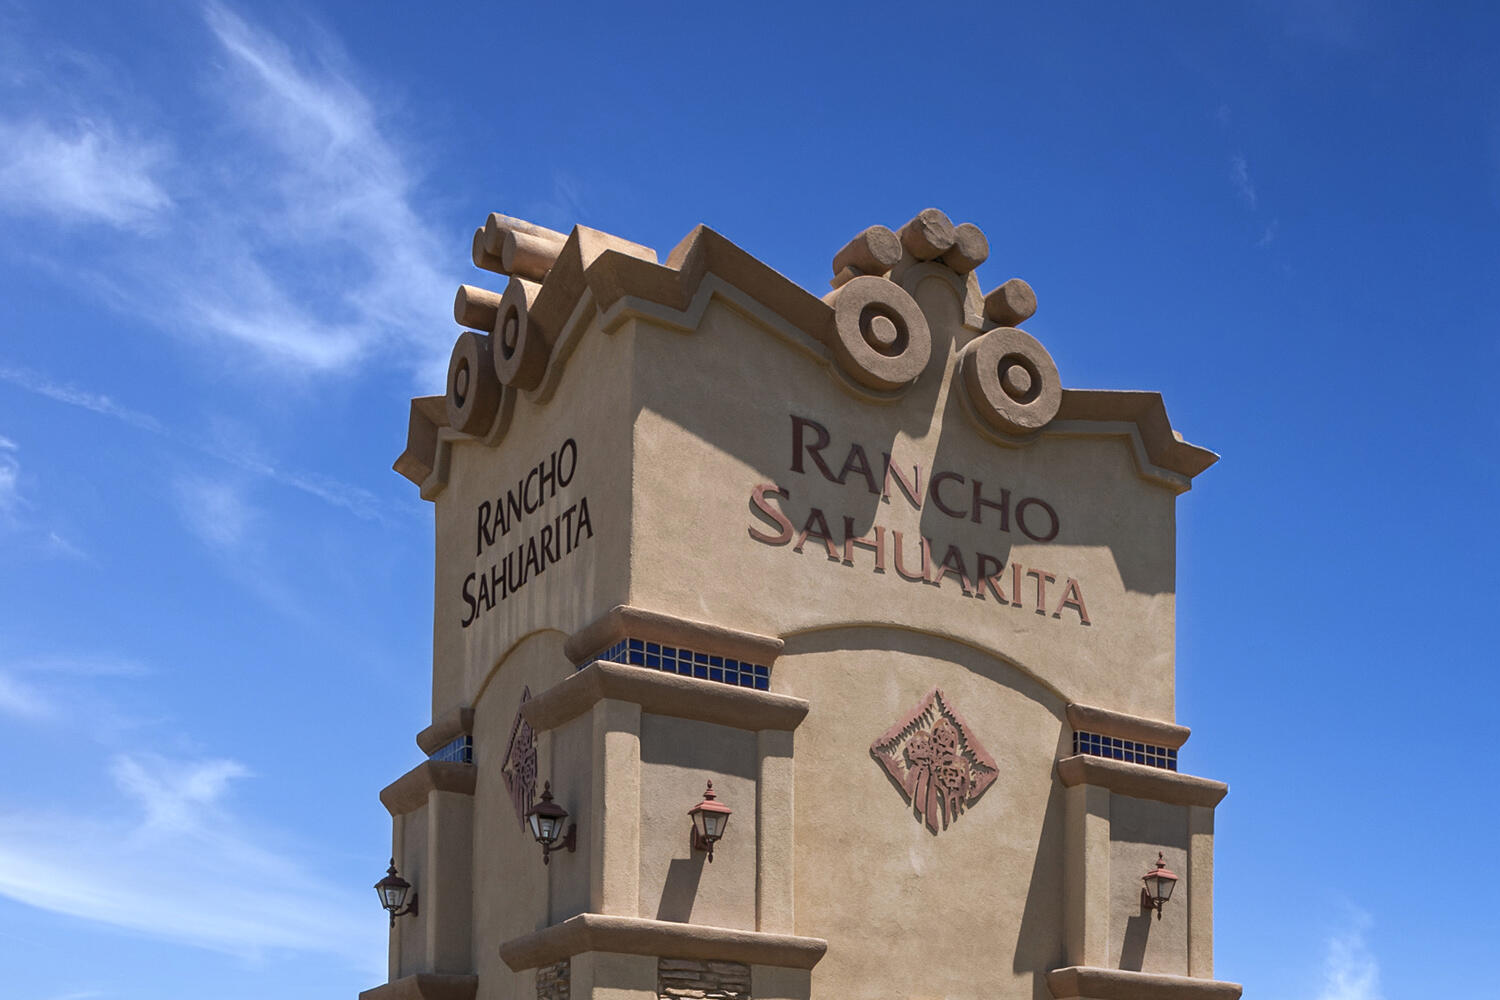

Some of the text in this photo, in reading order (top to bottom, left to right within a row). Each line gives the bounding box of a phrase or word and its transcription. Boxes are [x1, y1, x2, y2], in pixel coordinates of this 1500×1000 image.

[476, 438, 578, 557] RANCHO
[789, 414, 1060, 543] RANCHO
[461, 497, 593, 629] SAHUARITA
[748, 482, 1091, 626] SAHUARITA
